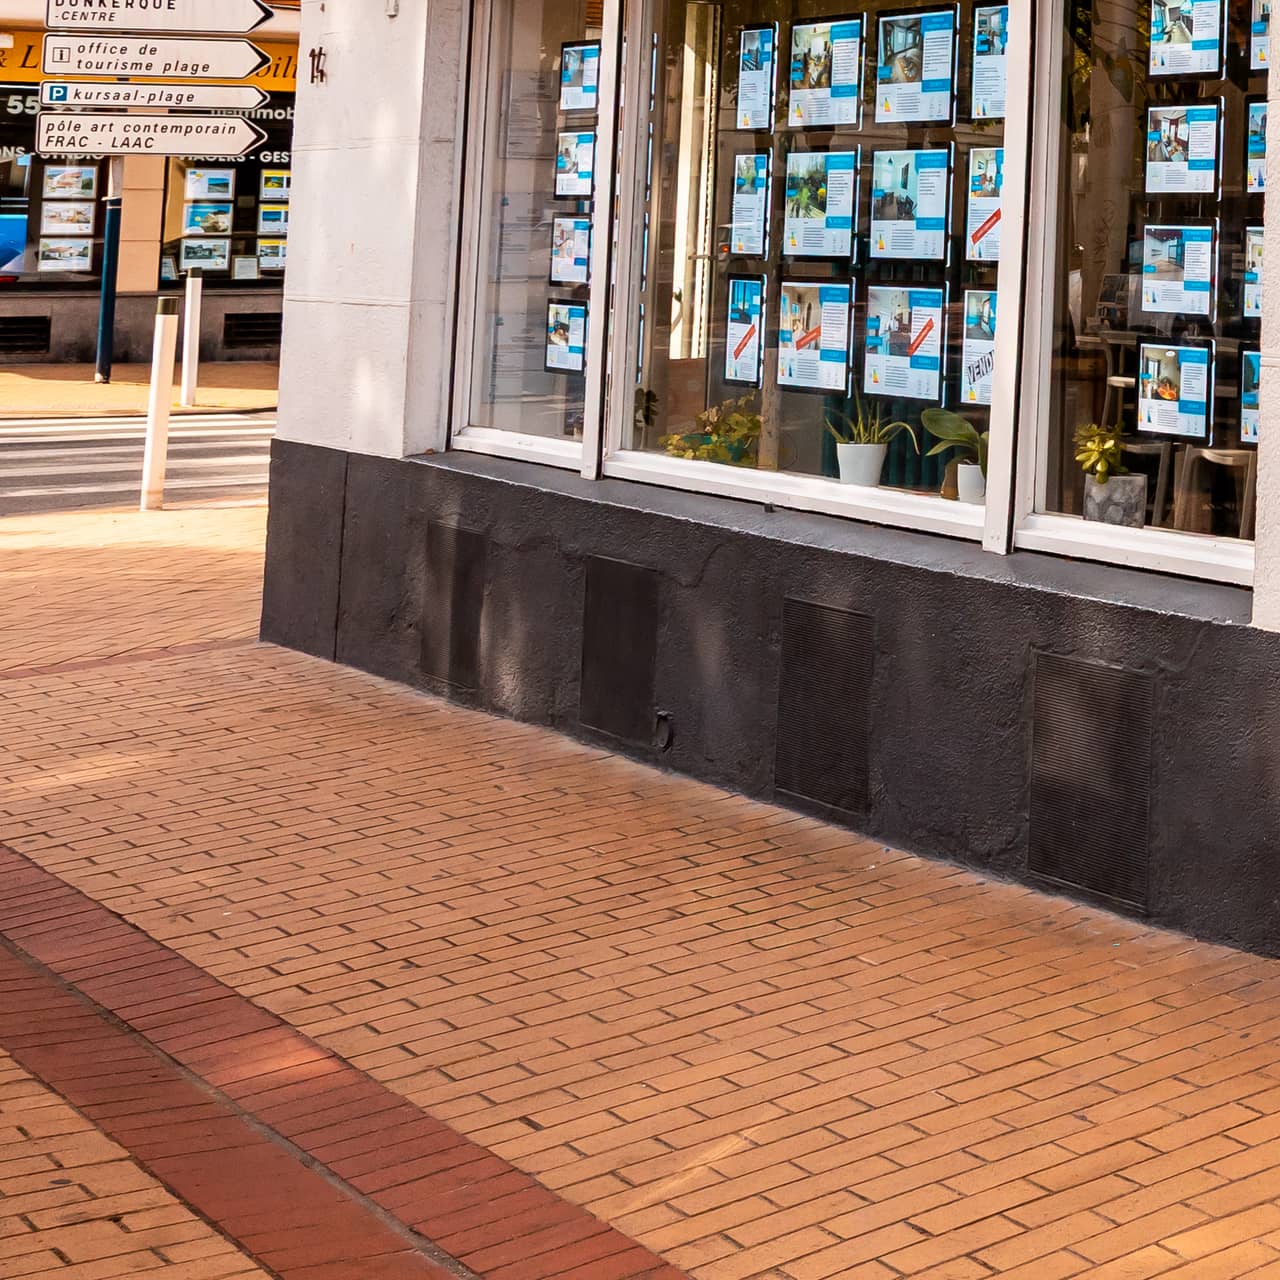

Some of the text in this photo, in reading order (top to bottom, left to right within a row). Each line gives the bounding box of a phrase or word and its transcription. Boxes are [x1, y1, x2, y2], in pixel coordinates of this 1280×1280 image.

[55, 11, 117, 22] -CENTRE
[77, 42, 158, 56] office de
[77, 59, 211, 75] tourisme plage
[73, 88, 195, 105] kursaal-plage
[46, 120, 237, 136] pôle art contemporain
[46, 136, 89, 148] FRAC
[111, 137, 155, 149] LAAC
